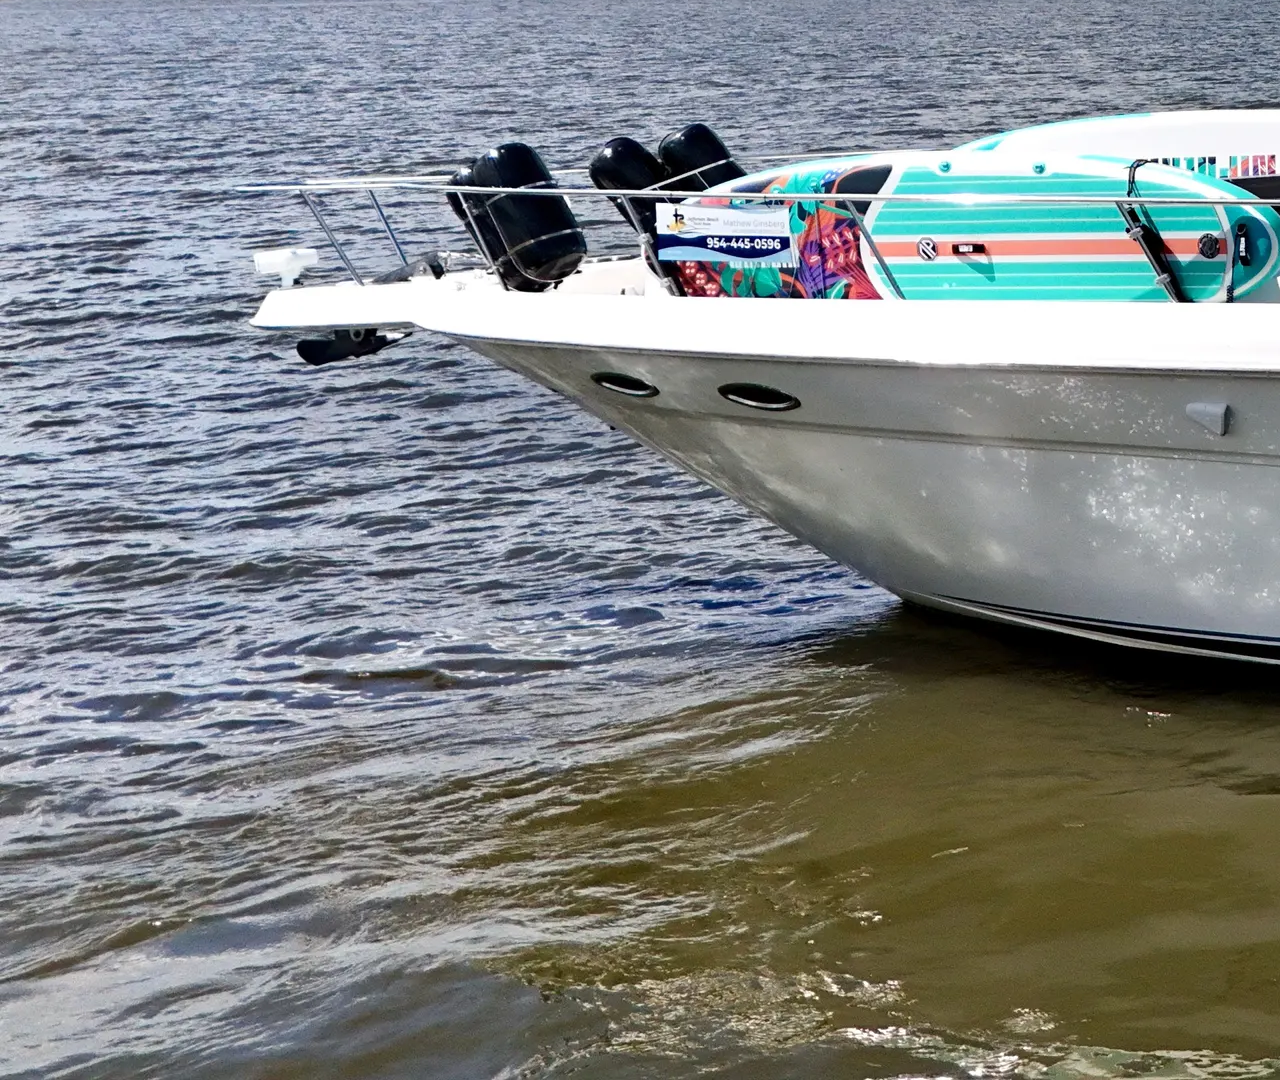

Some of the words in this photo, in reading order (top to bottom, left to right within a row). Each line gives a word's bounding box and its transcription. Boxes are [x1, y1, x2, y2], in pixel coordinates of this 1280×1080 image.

[723, 219, 751, 227] Mathew
[752, 219, 785, 230] Ginsberg
[706, 237, 781, 249] 954-445-0596
